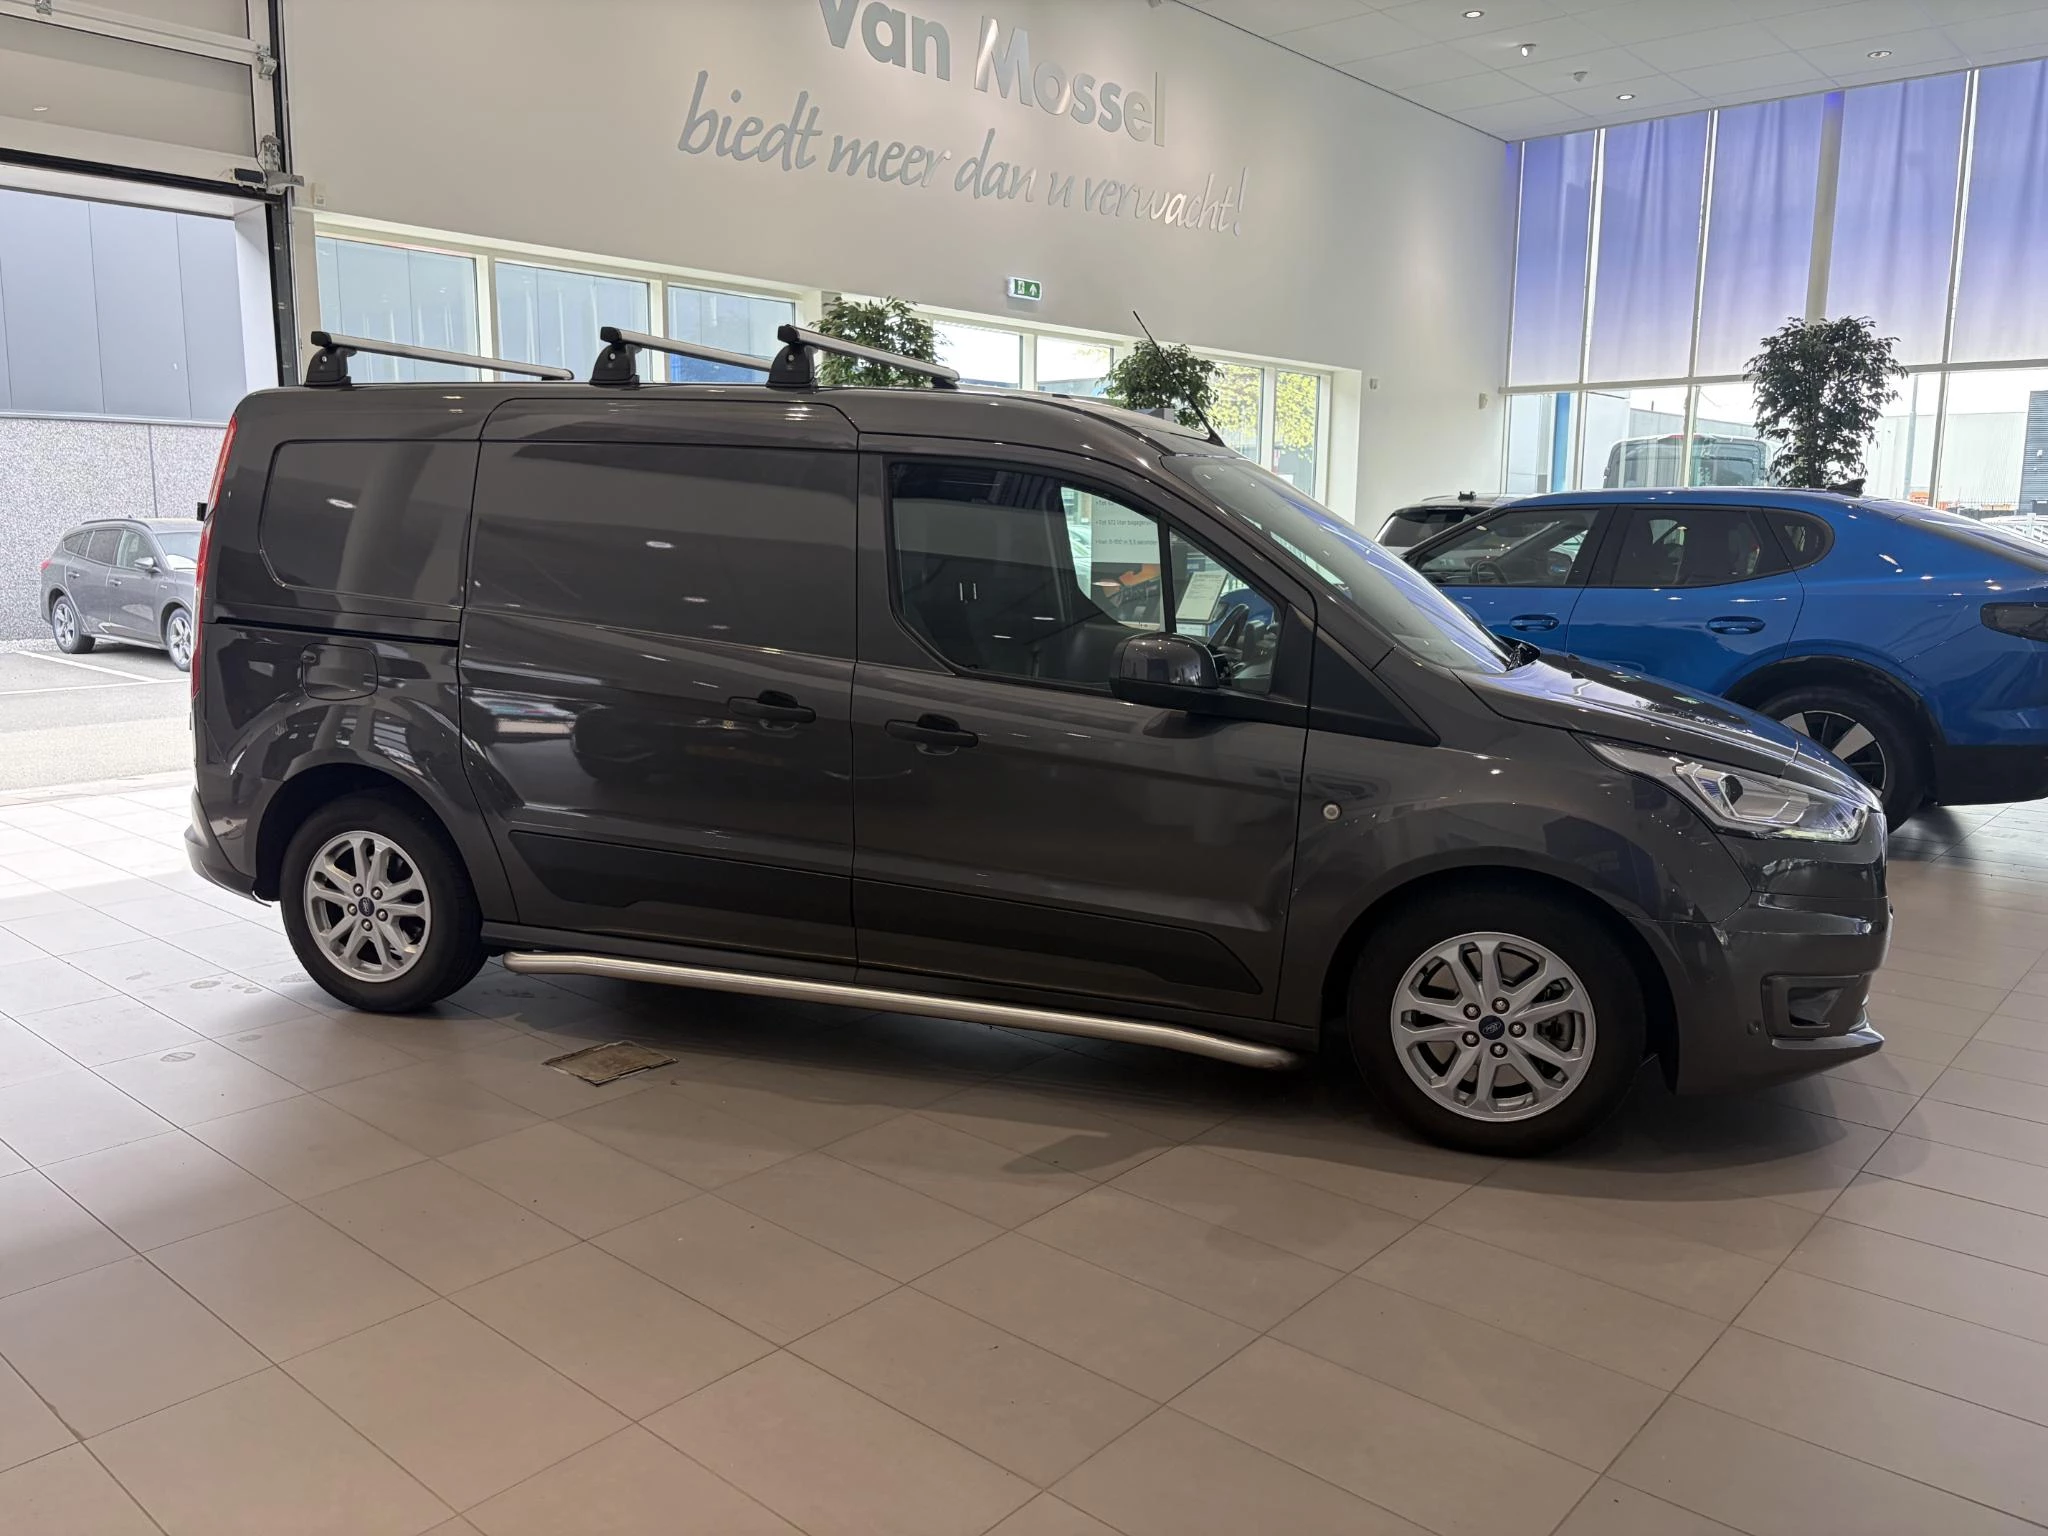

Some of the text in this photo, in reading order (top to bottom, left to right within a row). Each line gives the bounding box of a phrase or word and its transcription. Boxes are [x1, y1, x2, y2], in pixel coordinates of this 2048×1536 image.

[818, 0, 1166, 148] Van Mossel
[677, 69, 1248, 238] biedt meer dan u verwacht!
